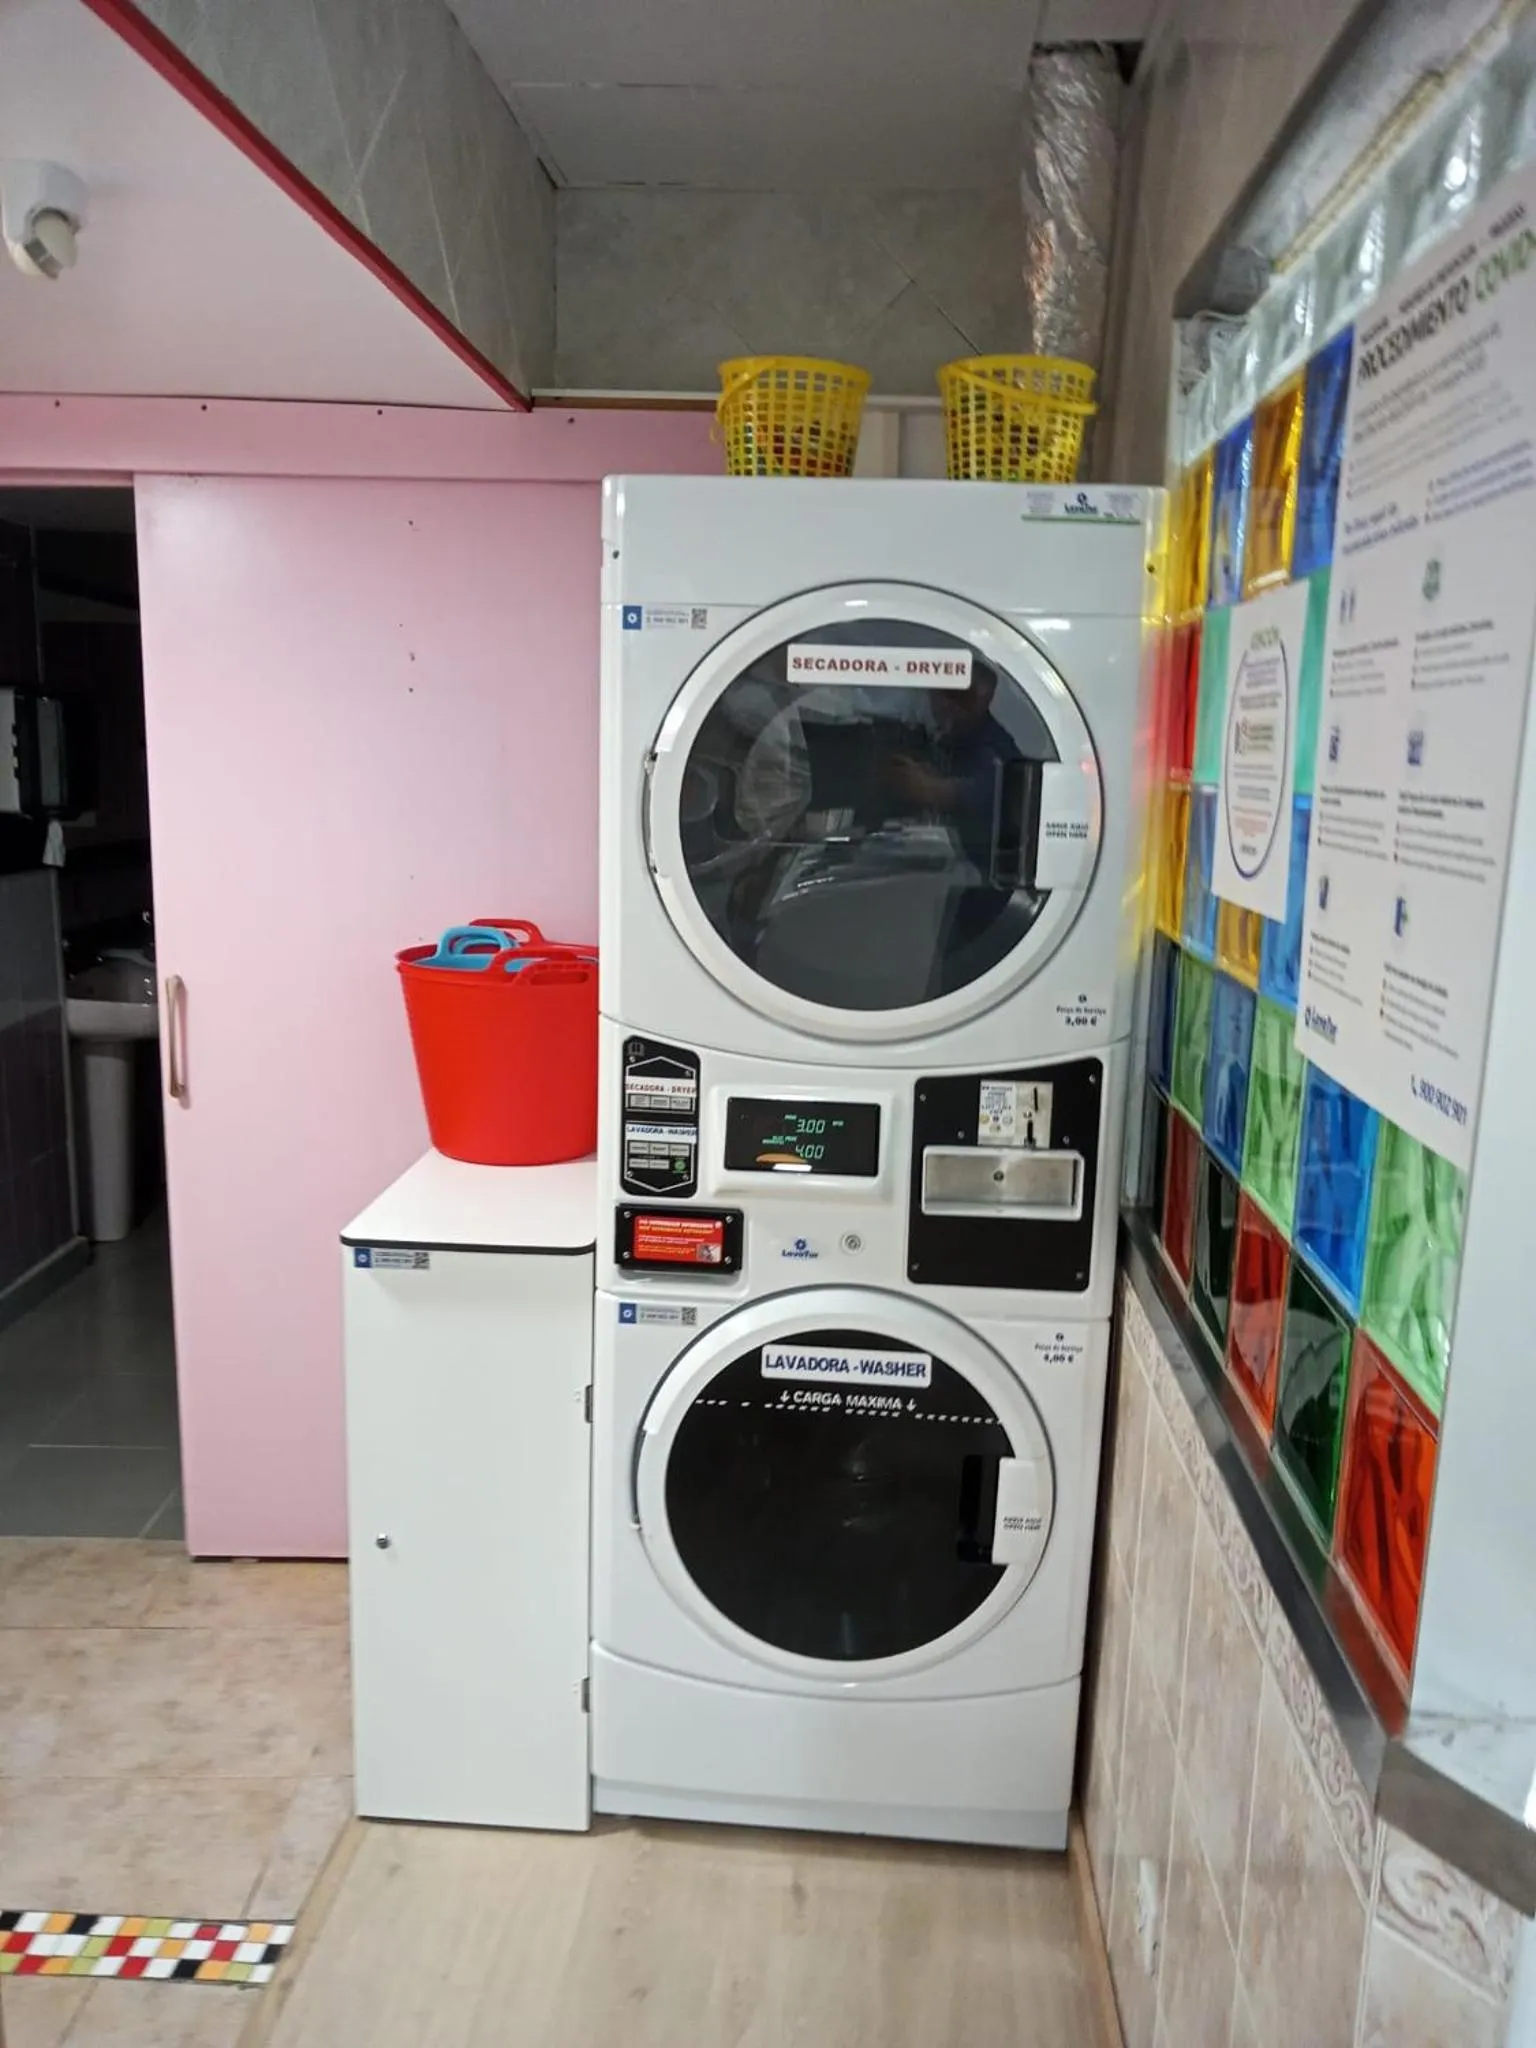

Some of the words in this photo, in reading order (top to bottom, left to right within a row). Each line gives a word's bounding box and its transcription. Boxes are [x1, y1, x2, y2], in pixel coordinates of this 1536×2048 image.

[792, 656, 889, 674] SECADORA
[906, 660, 967, 676] DRYER
[765, 1354, 850, 1374] LAVADORA
[793, 1390, 842, 1407] CARGA
[845, 1394, 903, 1411] MAXIMA
